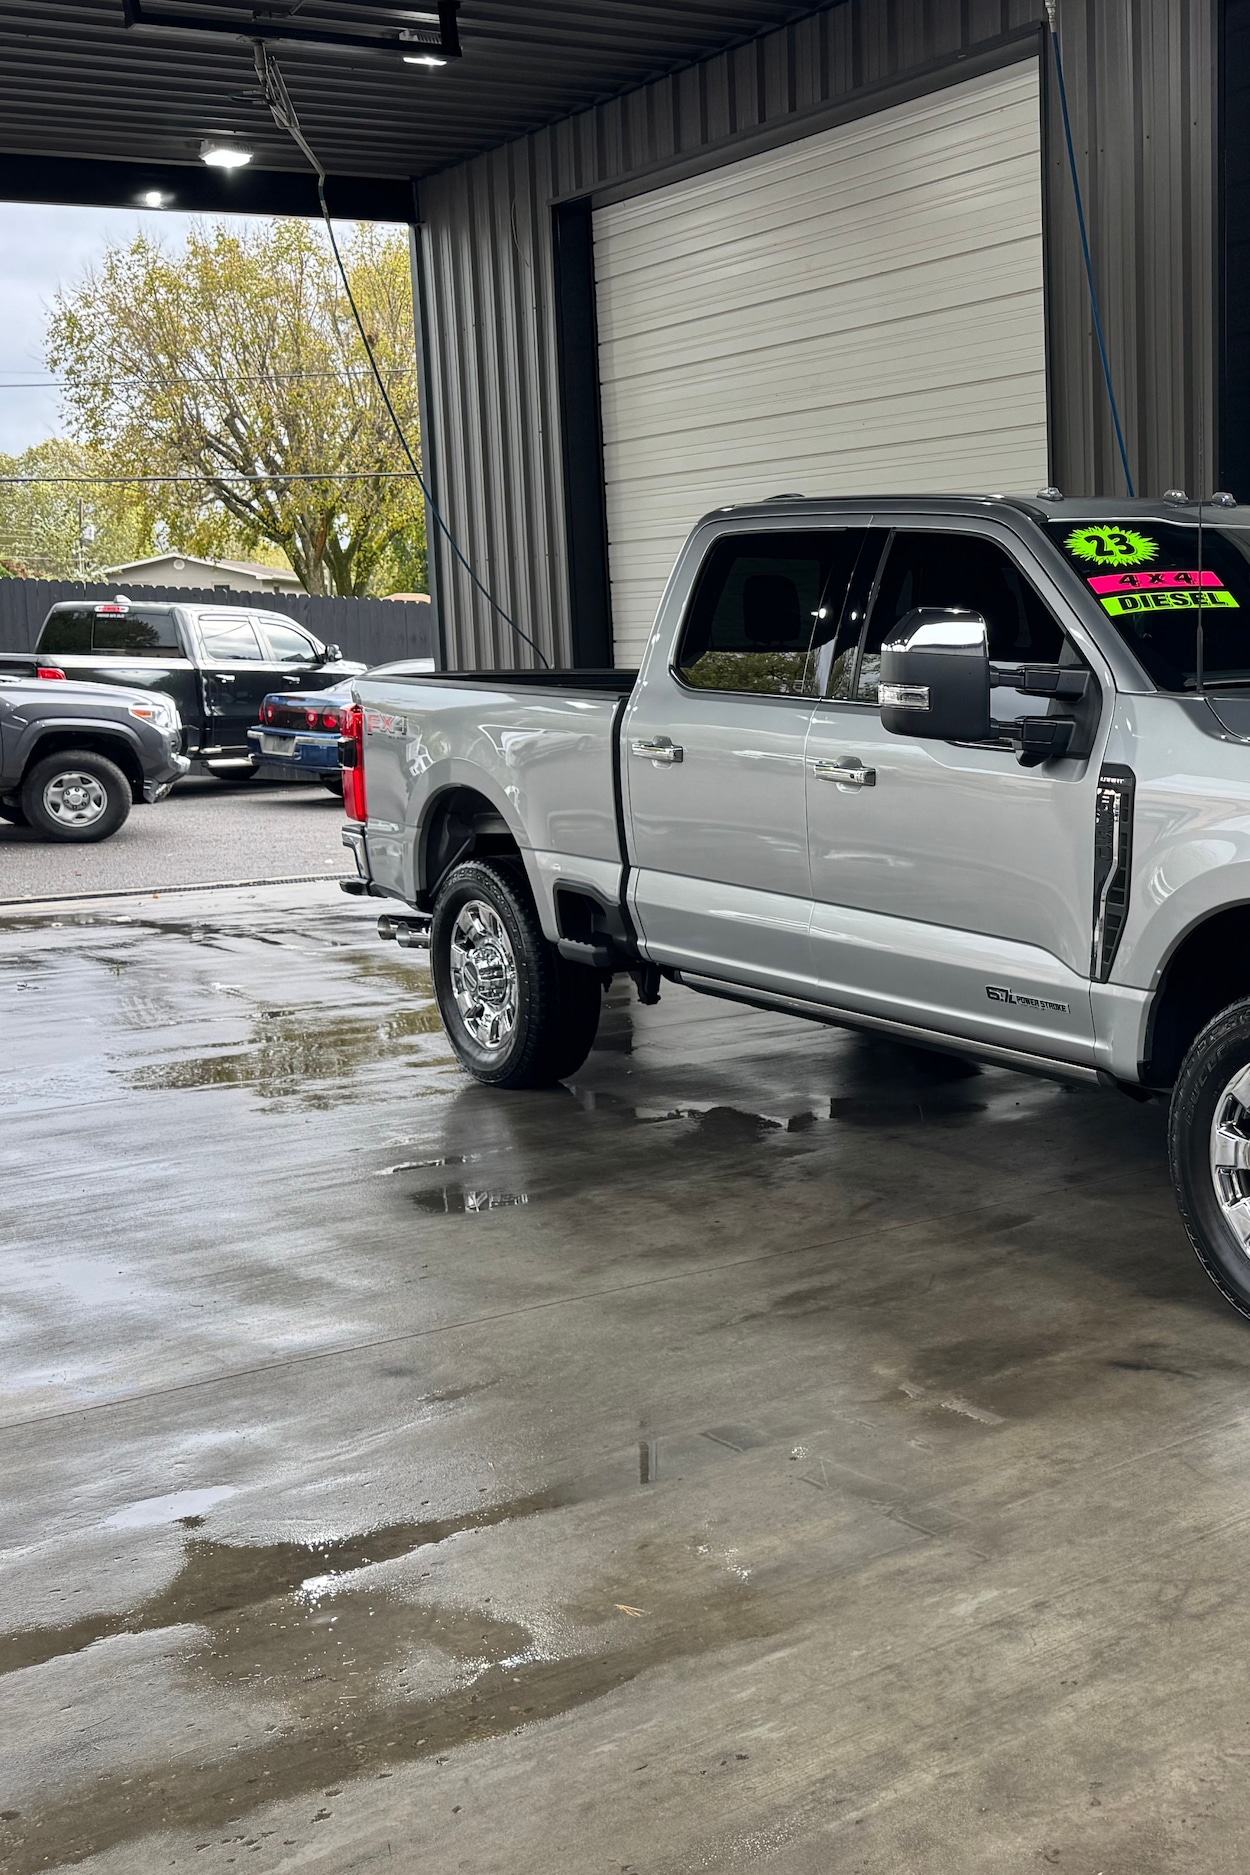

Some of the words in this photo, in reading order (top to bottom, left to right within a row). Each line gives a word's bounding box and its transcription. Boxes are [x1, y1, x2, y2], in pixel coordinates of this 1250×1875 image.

[1084, 533, 1136, 557] 23
[1118, 592, 1228, 612] DIESEL
[367, 713, 408, 736] FX4
[1016, 995, 1040, 1008] POWER
[1040, 999, 1067, 1013] STROKE
